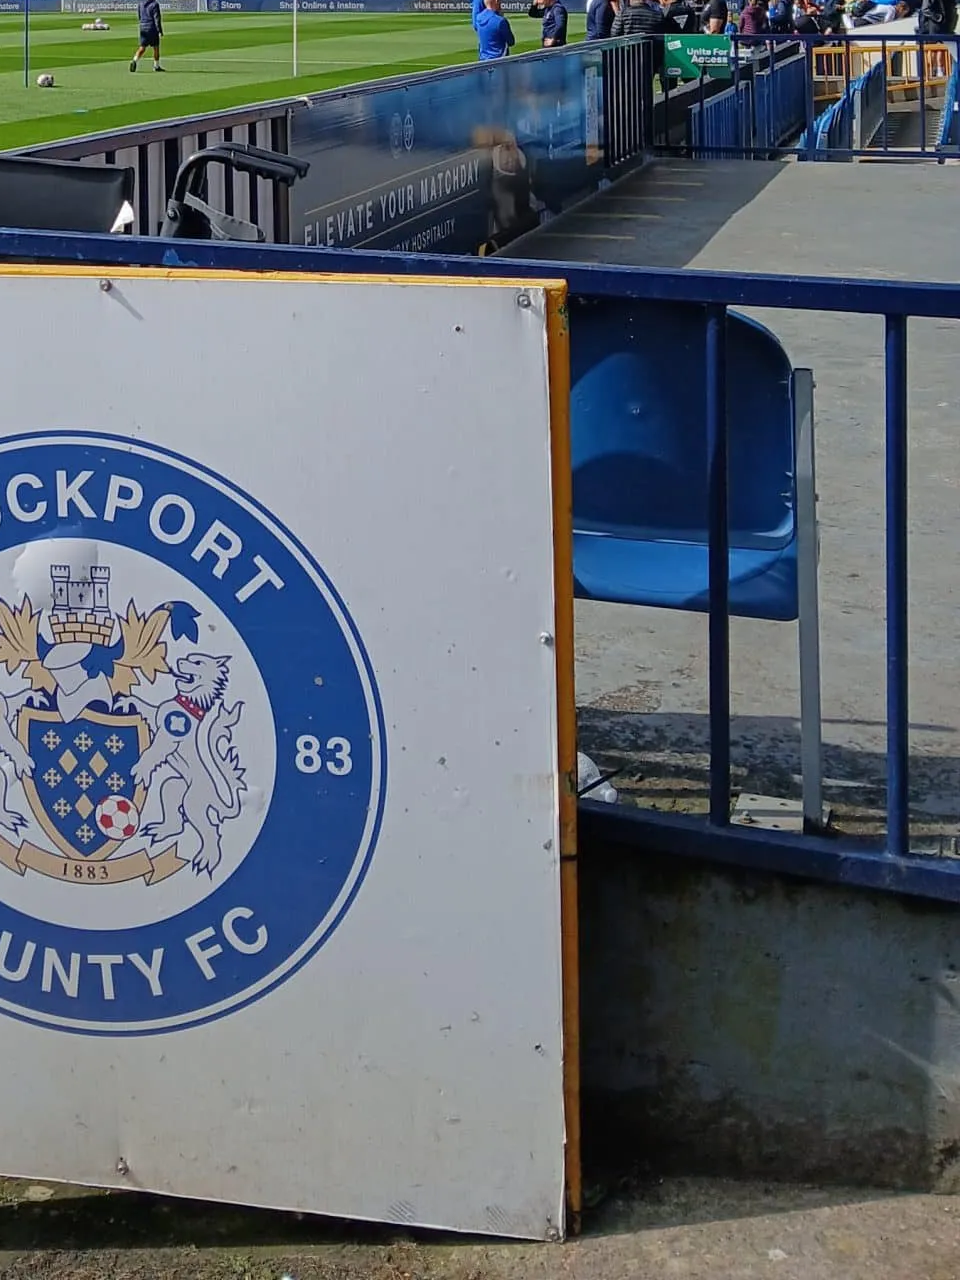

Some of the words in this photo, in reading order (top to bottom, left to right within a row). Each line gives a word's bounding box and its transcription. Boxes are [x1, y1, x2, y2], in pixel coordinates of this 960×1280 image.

[302, 1, 327, 10] Online
[690, 54, 729, 64] Access
[713, 47, 729, 56] For
[304, 198, 374, 248] ELEVATE
[379, 183, 414, 222] YOUR
[420, 157, 480, 206] MATCHDAY
[411, 217, 456, 252] HOSPITALITY
[294, 735, 353, 777] 83
[62, 862, 109, 880] 1883
[185, 906, 269, 980] FC
